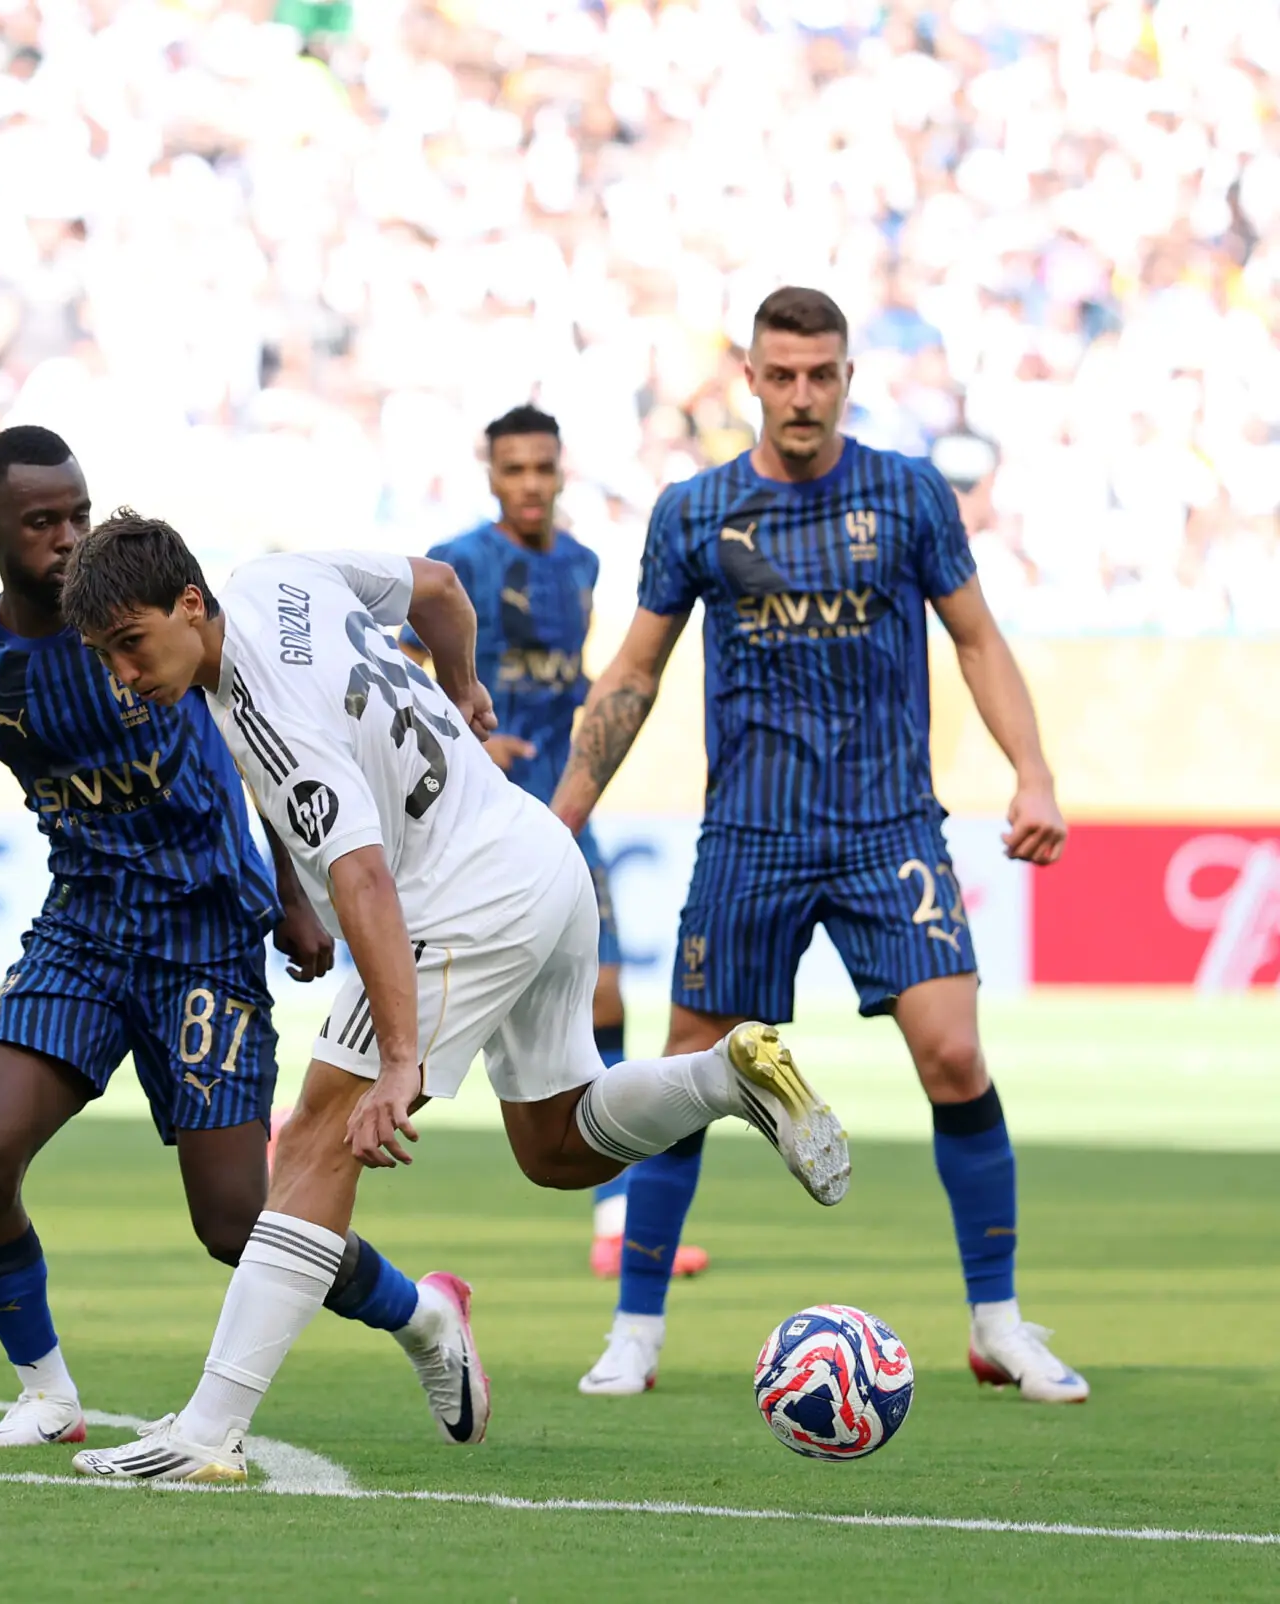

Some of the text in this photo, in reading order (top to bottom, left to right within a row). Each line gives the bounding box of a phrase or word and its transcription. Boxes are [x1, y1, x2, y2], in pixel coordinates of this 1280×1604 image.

[278, 583, 313, 666] GONZALO
[735, 586, 873, 630] SAVVY
[344, 611, 461, 819] 30
[34, 750, 161, 812] SAVVY
[289, 783, 333, 846] hp
[180, 988, 257, 1073] 87
